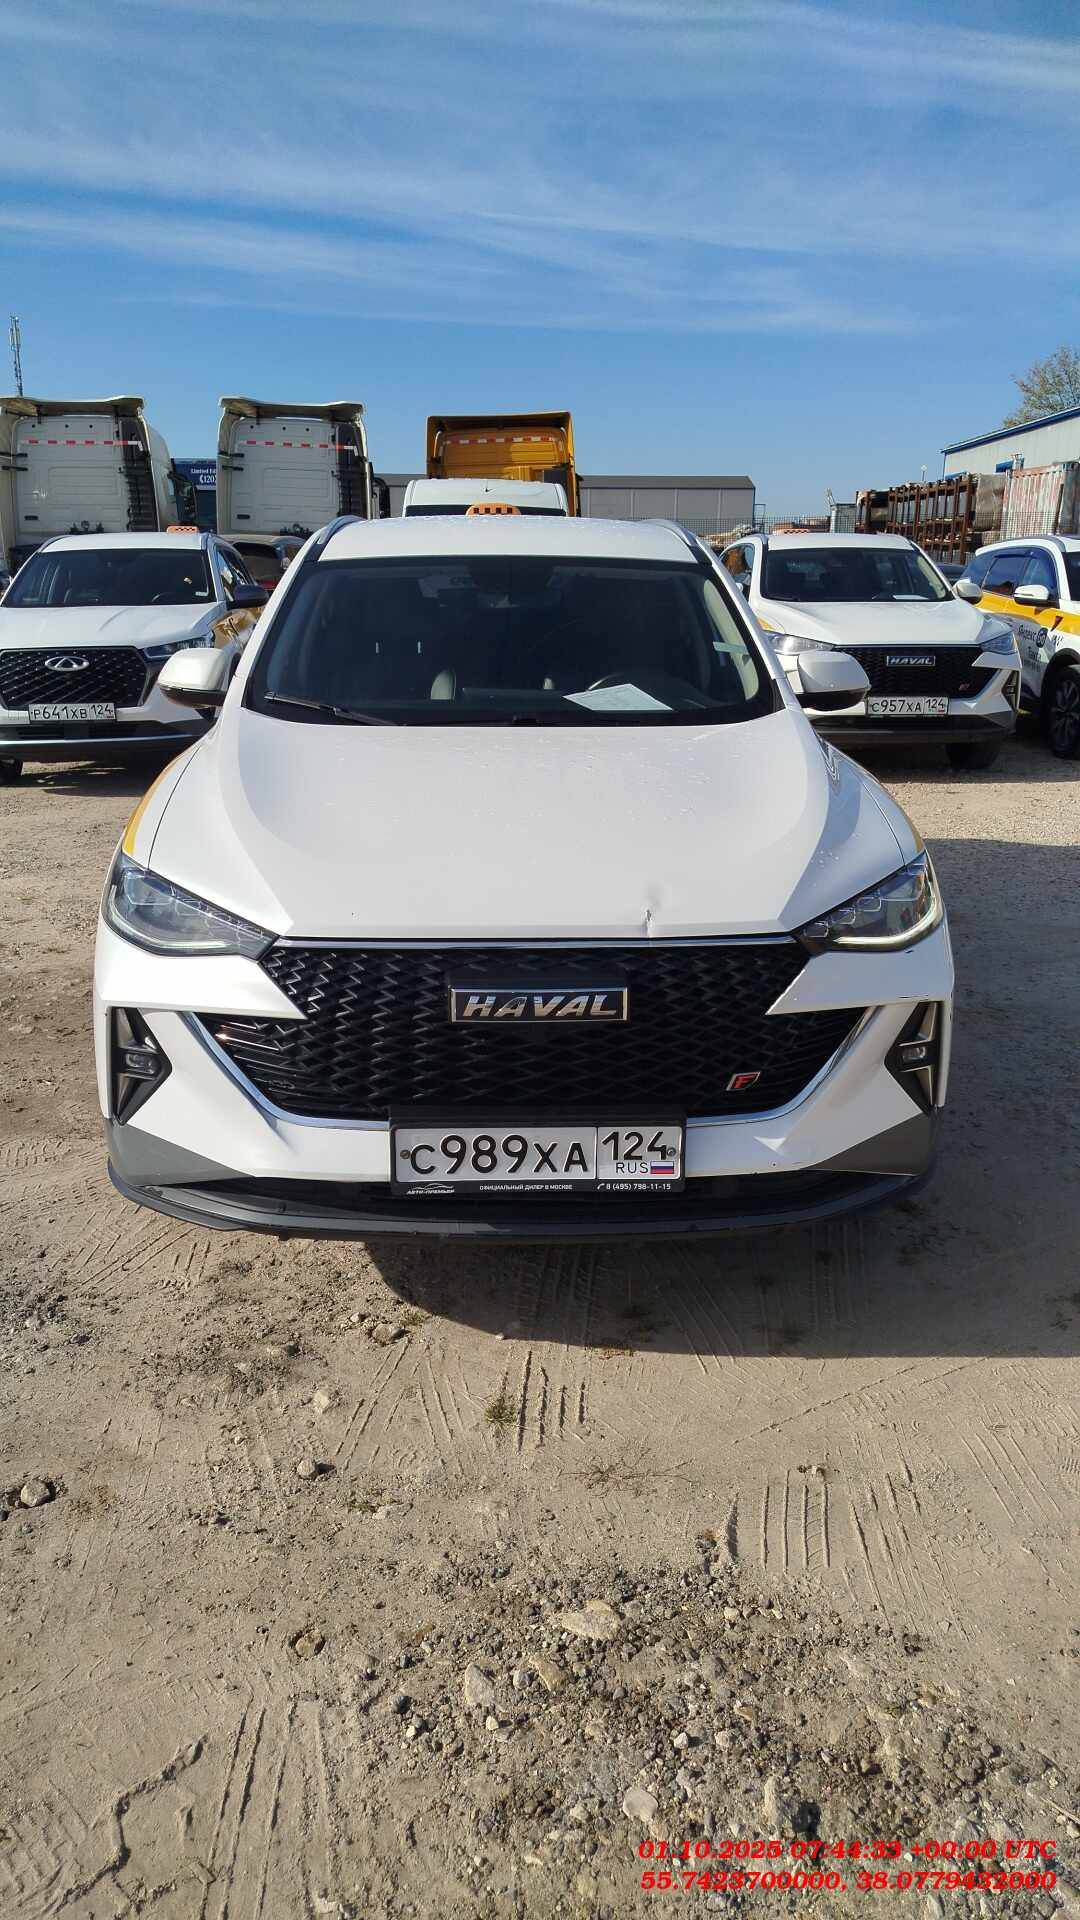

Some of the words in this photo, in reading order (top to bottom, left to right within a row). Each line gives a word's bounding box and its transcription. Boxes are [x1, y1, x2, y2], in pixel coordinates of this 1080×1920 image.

[890, 657, 933, 665] HAVAL
[33, 705, 88, 719] Р641ХВ
[91, 703, 112, 715] 124
[871, 699, 922, 713] С957ХА
[926, 698, 945, 709] 124
[462, 994, 617, 1018] HAVAL
[410, 1134, 588, 1175] С989ХА
[602, 1130, 668, 1161] 124
[615, 1161, 649, 1174] RUS
[612, 1183, 632, 1191] (495)
